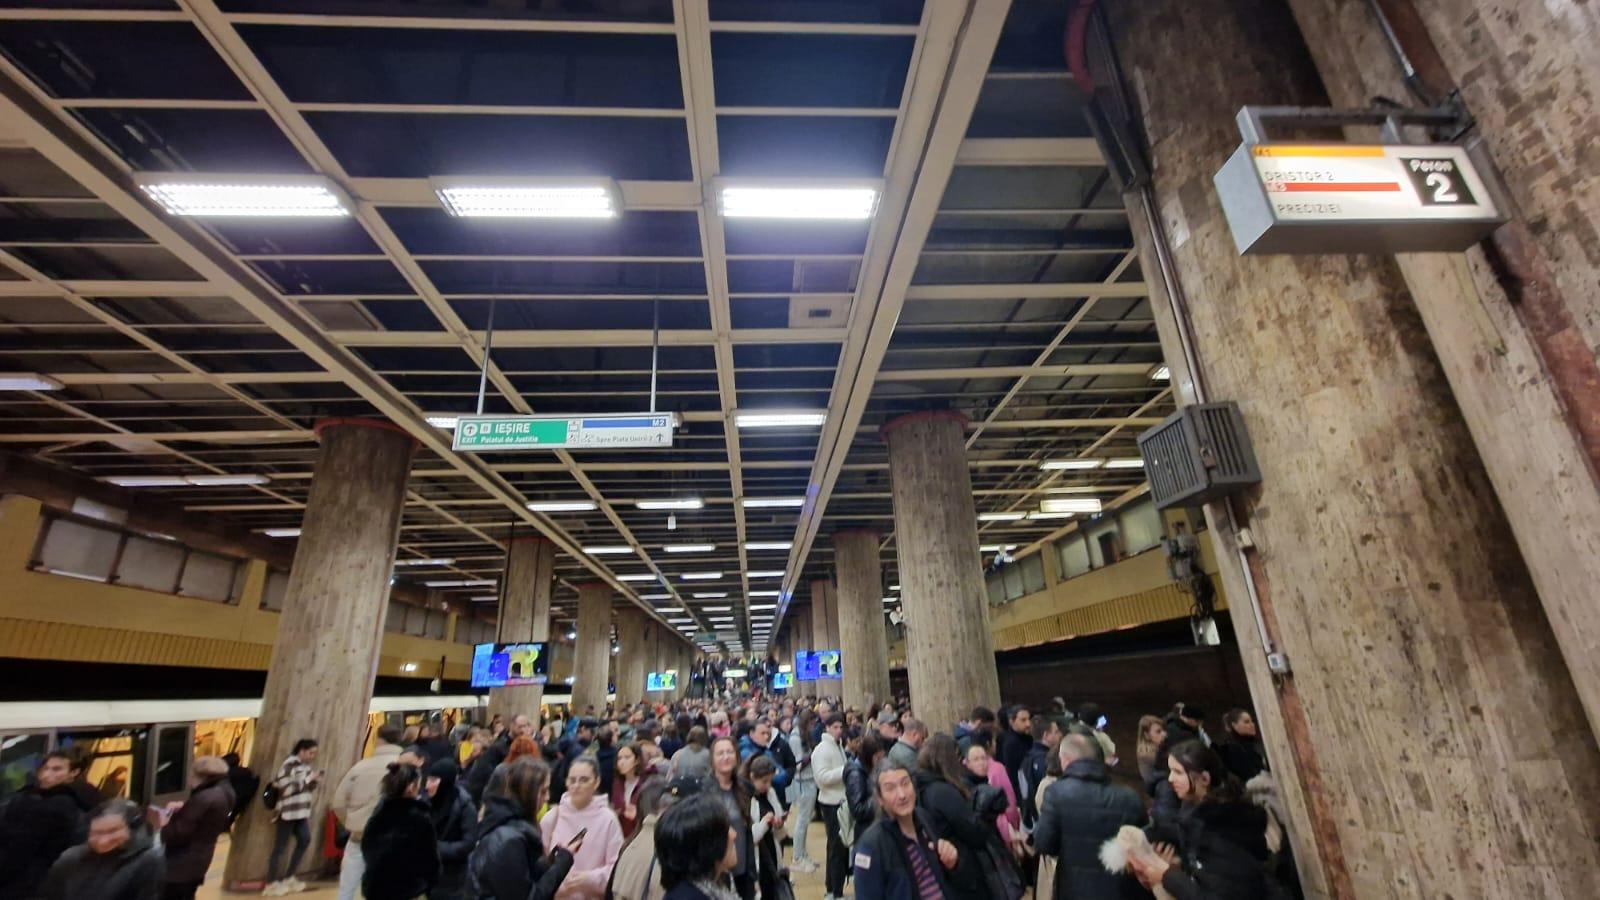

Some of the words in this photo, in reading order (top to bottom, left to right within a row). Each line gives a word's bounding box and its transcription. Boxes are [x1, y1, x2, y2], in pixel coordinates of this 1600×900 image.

[1264, 171, 1321, 182] DRISTOR
[1325, 171, 1335, 182] 2
[1426, 173, 1458, 202] 2
[1277, 203, 1342, 214] PRECIZIEI
[651, 418, 665, 427] M2
[462, 436, 478, 444] EXIT
[480, 436, 504, 444] Palatul
